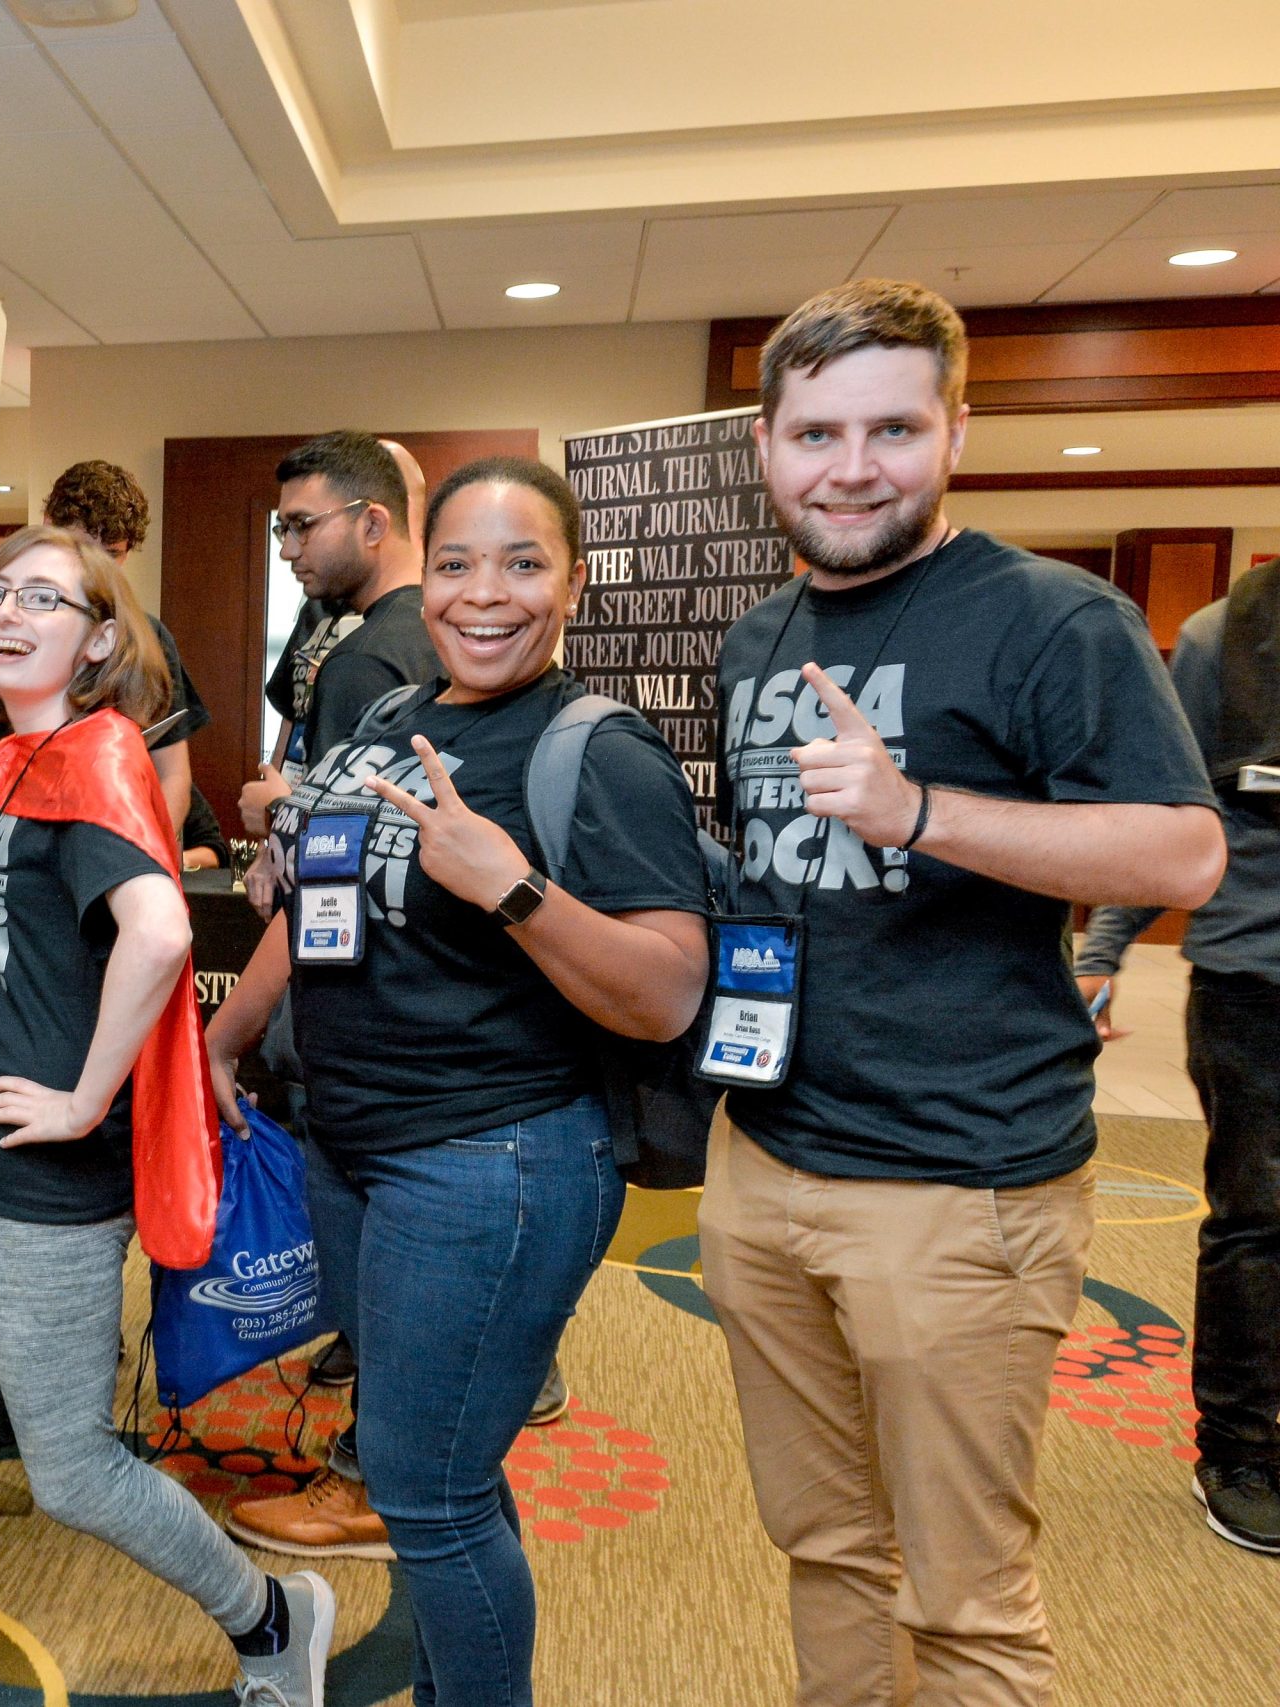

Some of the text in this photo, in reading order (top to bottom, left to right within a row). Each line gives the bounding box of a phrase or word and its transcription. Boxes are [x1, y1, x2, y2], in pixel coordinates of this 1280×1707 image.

[570, 437, 624, 462] WALL
[664, 453, 711, 494] THE
[644, 494, 750, 540] JOURNAL.
[587, 547, 634, 586] THE
[637, 543, 698, 581] WALL
[600, 587, 686, 626] STREET
[640, 629, 721, 667] JOURNA
[634, 674, 695, 710] WALL
[740, 1010, 758, 1022] Brian
[242, 1273, 293, 1294] Community
[232, 1295, 317, 1329] (203) 285-2000
